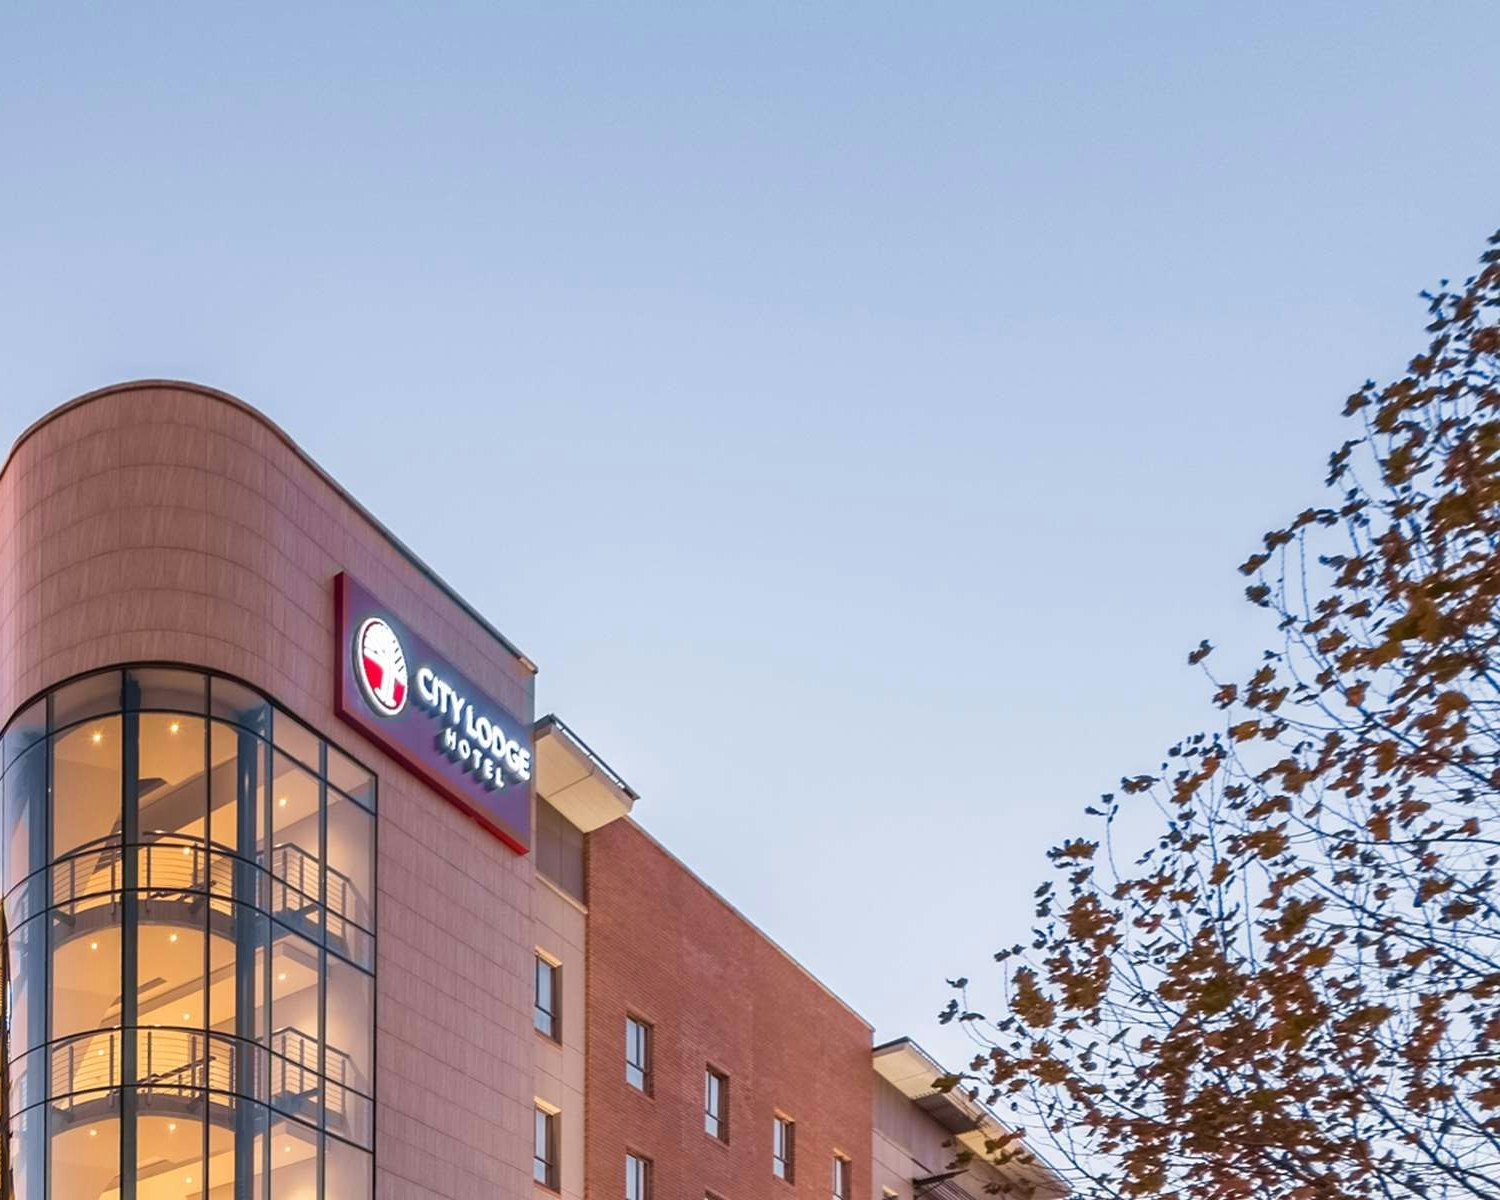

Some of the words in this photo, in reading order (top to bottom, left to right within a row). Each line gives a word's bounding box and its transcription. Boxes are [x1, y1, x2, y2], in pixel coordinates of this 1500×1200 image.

[416, 667, 466, 725] CITY
[466, 704, 531, 782] LODGE
[444, 726, 505, 789] HOTEL
